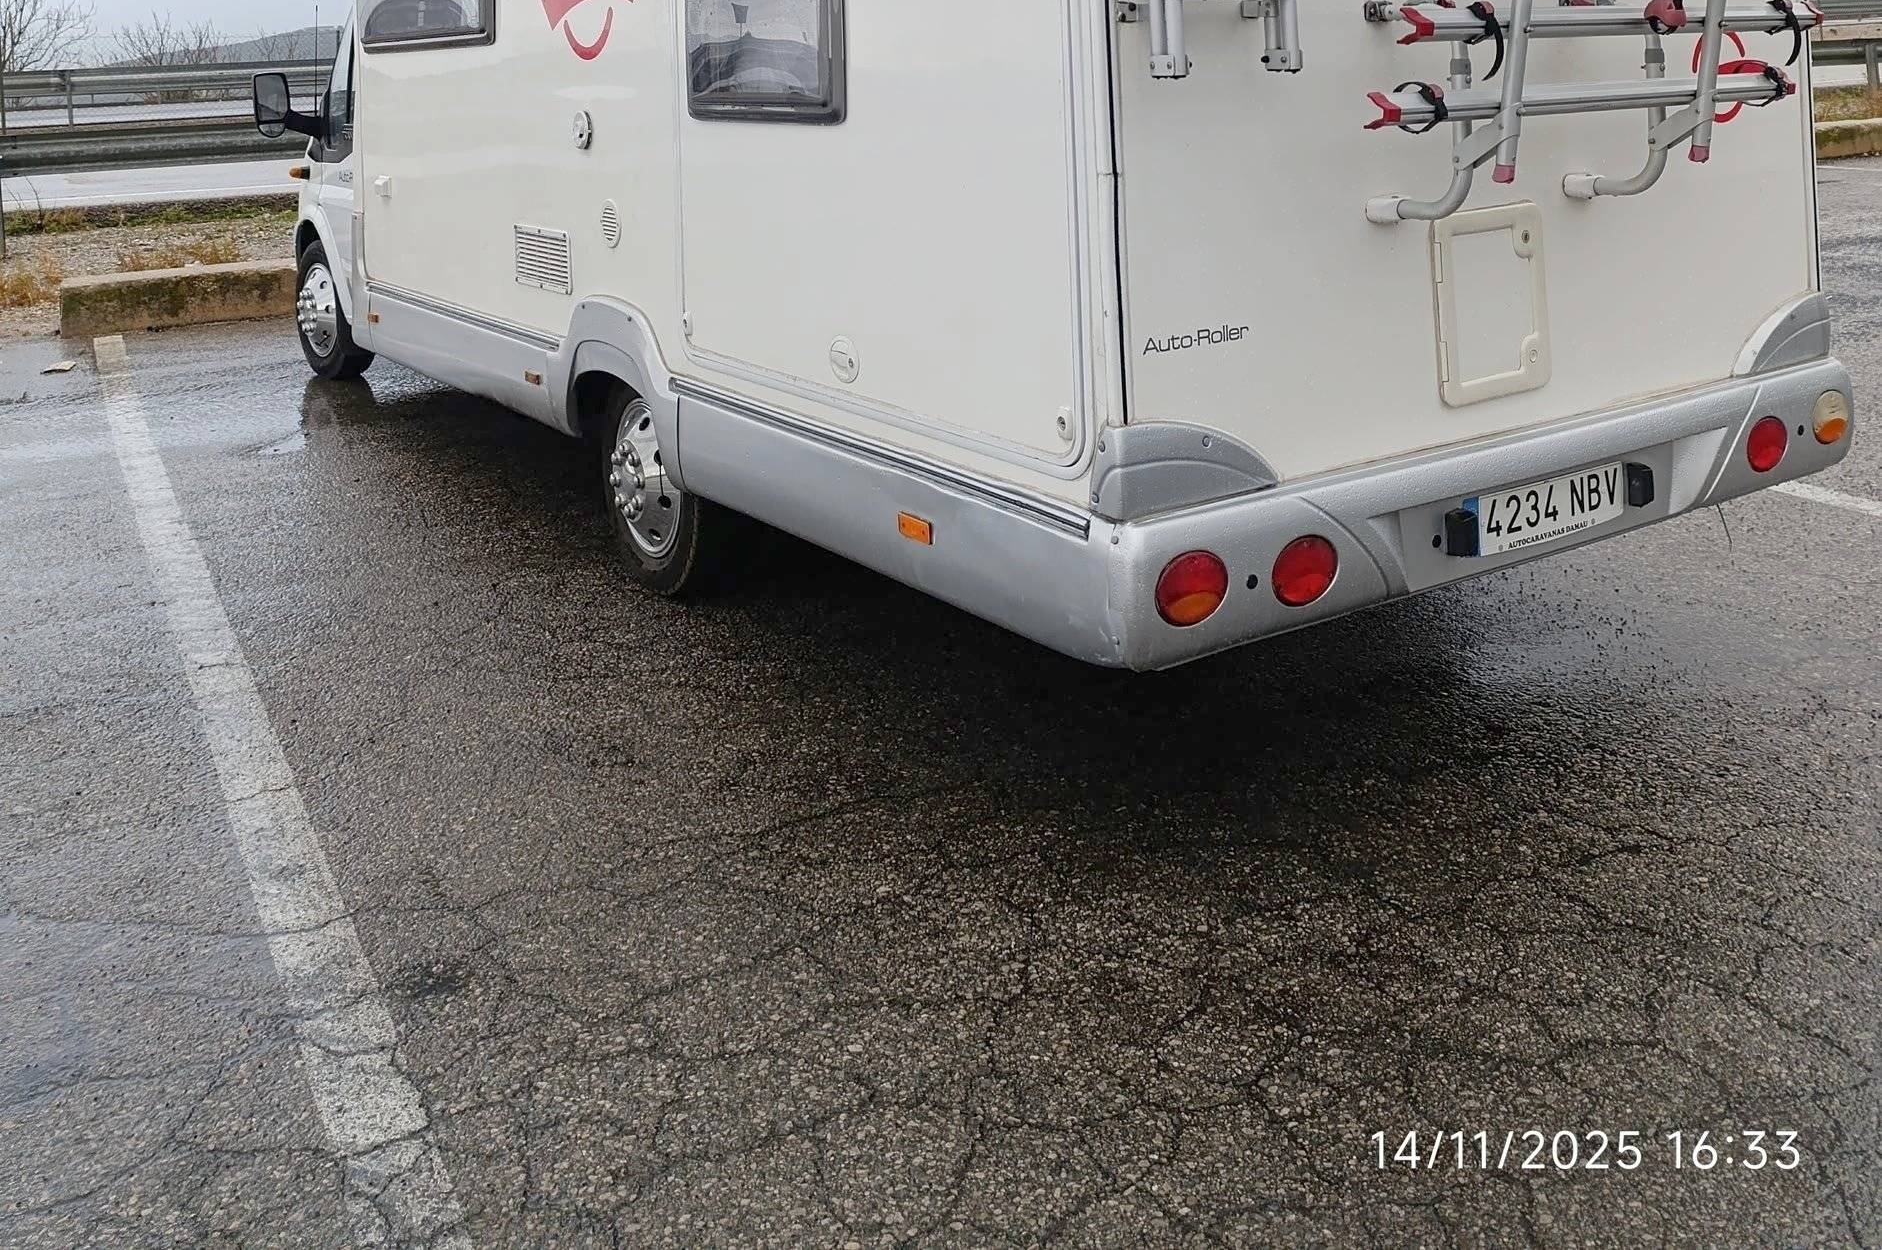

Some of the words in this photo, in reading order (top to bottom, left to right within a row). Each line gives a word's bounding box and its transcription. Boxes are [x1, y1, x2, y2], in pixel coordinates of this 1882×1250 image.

[1142, 324, 1250, 356] Auto-Roller
[1486, 483, 1559, 537] 4234
[1570, 467, 1618, 517] NBV
[1507, 526, 1566, 550] AUTOCARAVANAS
[1565, 520, 1589, 535] DAMAU
